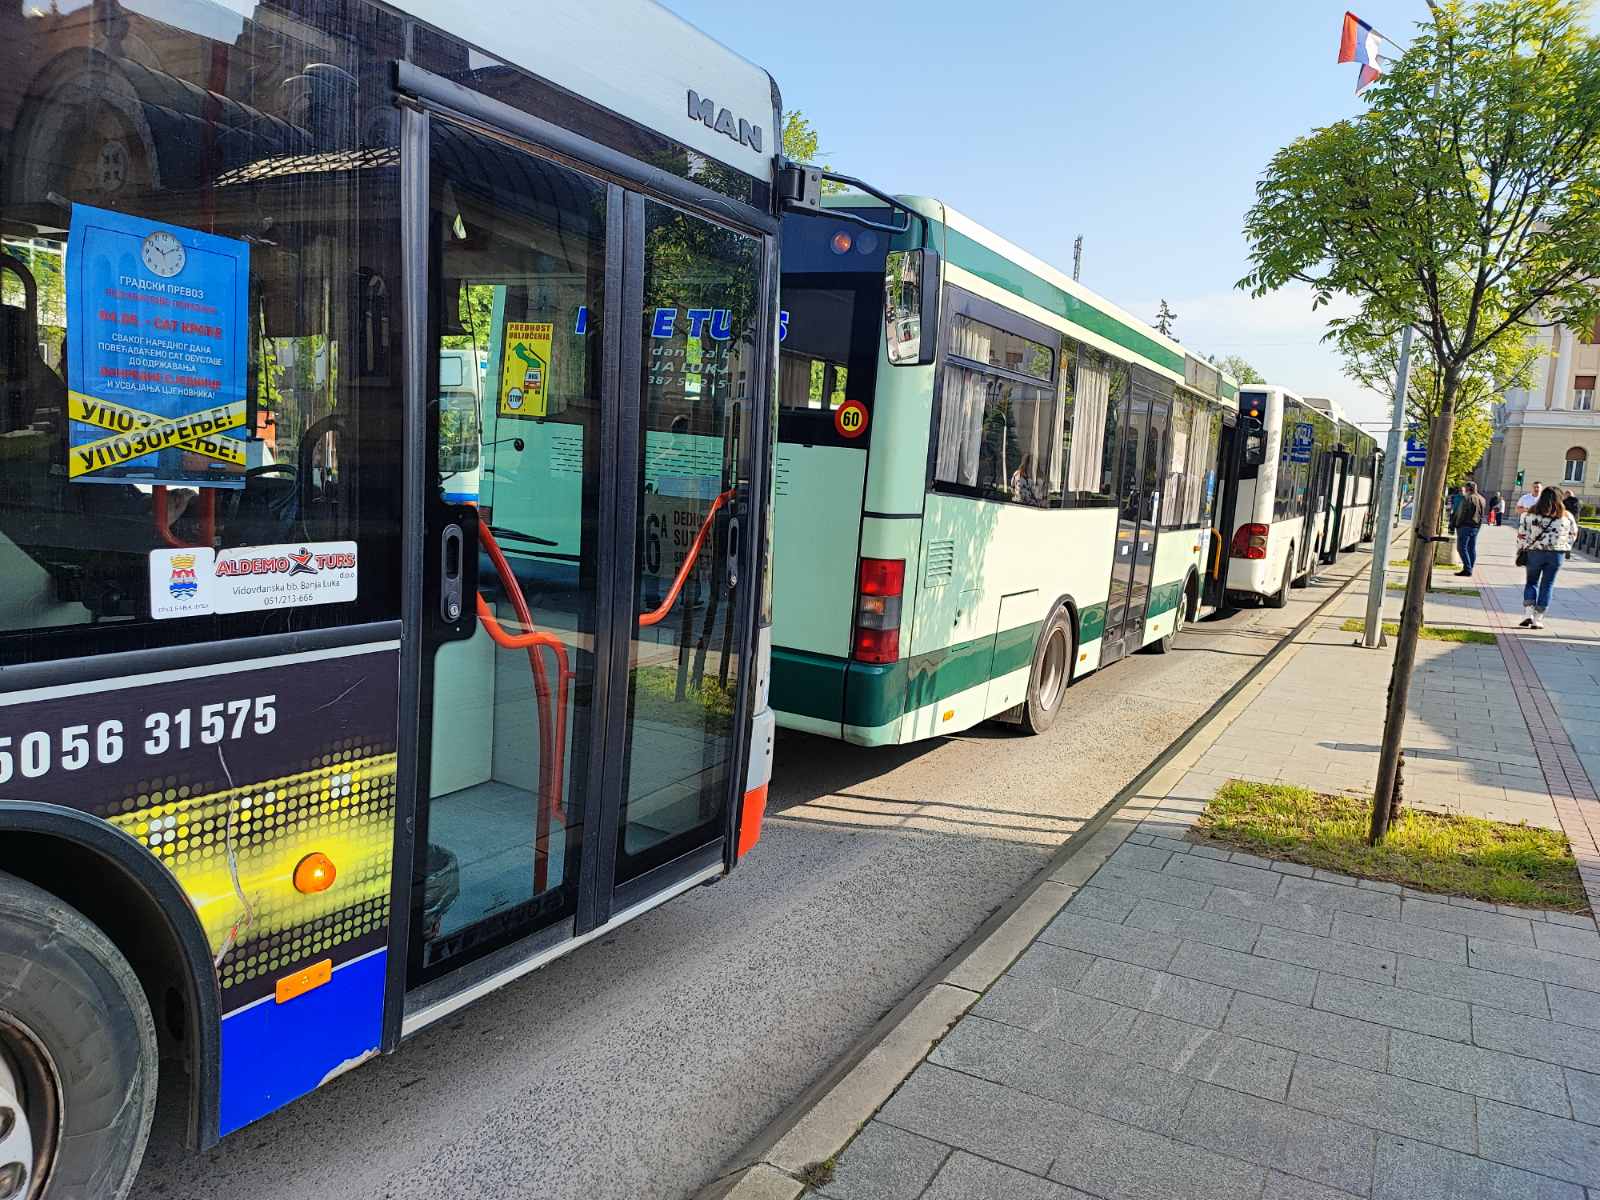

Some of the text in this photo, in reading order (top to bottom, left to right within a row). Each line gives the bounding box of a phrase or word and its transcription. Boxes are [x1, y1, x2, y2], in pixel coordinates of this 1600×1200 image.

[687, 88, 762, 154] MAN
[119, 276, 204, 299] ГРАДСКИ ПРЕВОЗ
[111, 332, 144, 343] СВАКОГ
[189, 343, 211, 354] ДАНА
[128, 356, 141, 367] ДО
[509, 394, 521, 403] STOP
[843, 411, 860, 427] 60
[78, 406, 233, 470] УПОЗОРЕЊЕ!
[215, 553, 355, 577] ALDEMO TURS
[232, 584, 285, 596] Vidovdanska
[300, 580, 322, 592] Banja
[323, 579, 341, 588] Luka
[144, 694, 276, 756] 31575
